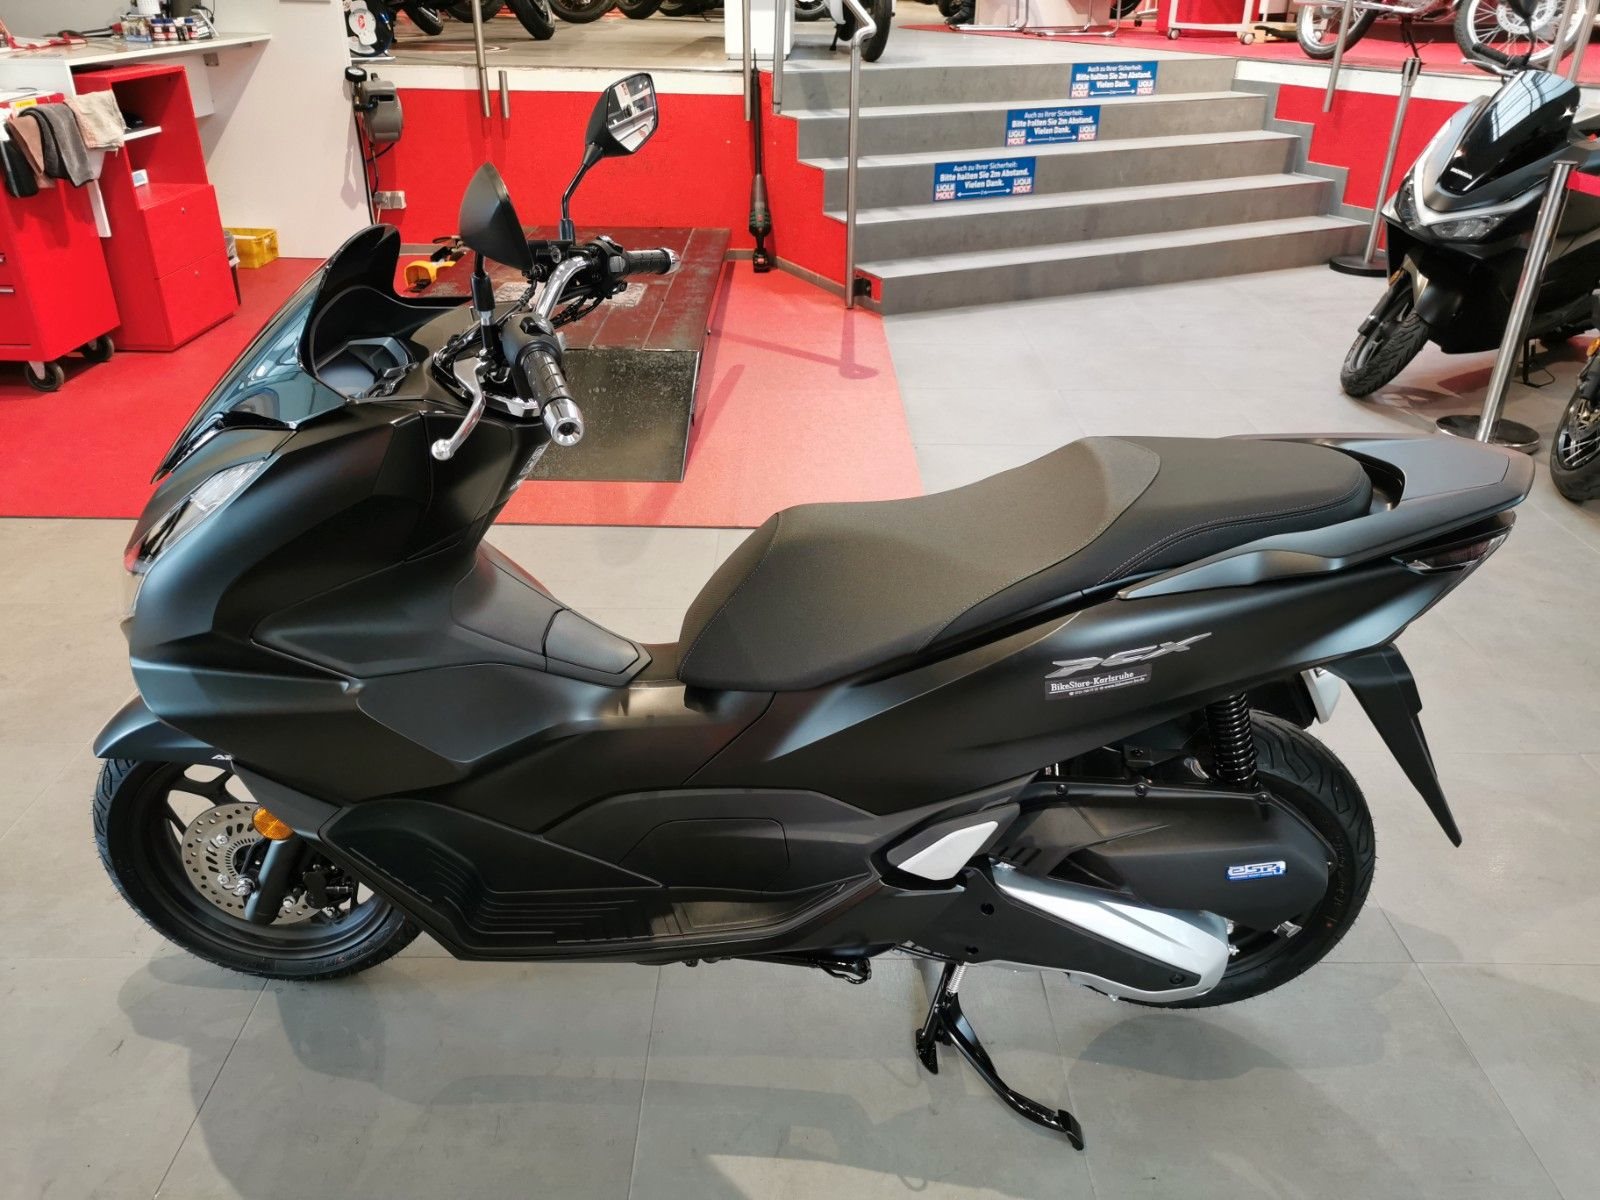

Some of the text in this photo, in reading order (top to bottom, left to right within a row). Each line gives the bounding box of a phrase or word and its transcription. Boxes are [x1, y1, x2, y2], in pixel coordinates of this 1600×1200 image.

[979, 171, 989, 179] Sie
[965, 181, 985, 189] Vielen
[1050, 672, 1135, 691] BikeStore-Karlsruhe
